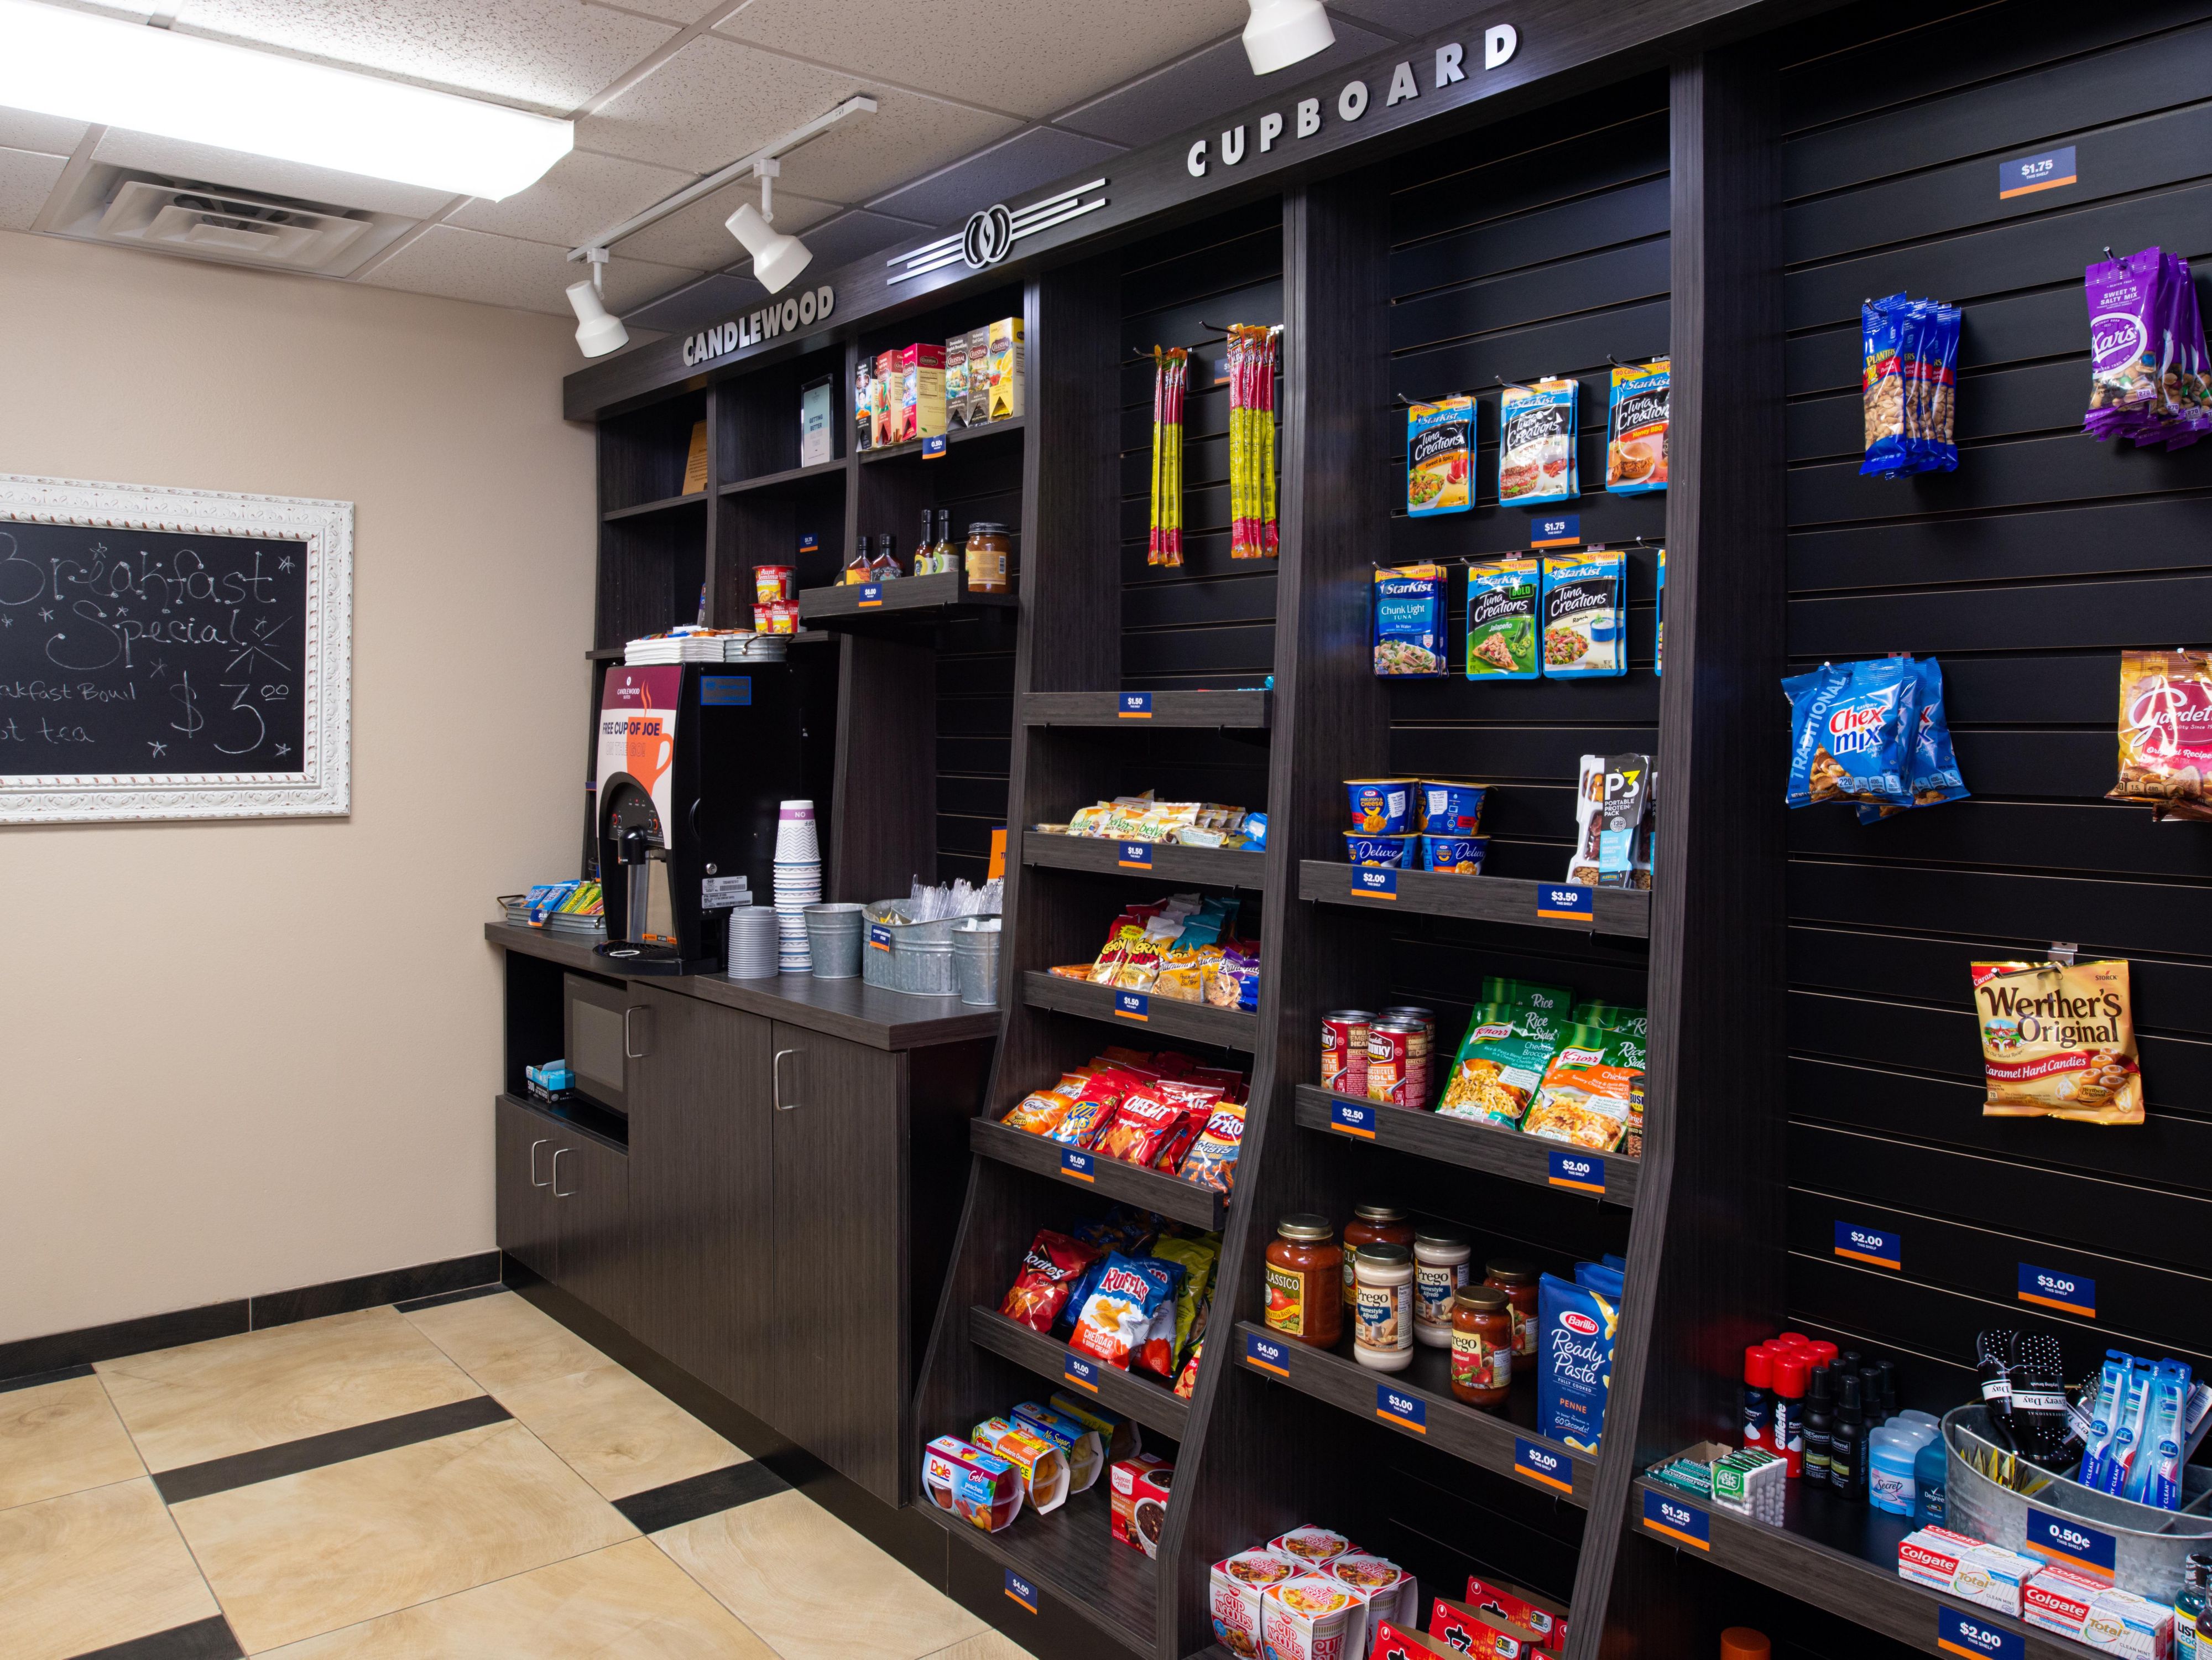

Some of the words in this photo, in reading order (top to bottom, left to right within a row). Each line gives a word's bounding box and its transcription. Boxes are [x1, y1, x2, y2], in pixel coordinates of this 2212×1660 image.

[1187, 24, 1517, 178] CUPBOARD
[2021, 160, 2053, 176] $1.75
[2100, 296, 2121, 305] SALTY
[2124, 292, 2137, 300] MIX
[2104, 290, 2127, 299] SWEET
[682, 285, 836, 367] CANDLEWOOD
[969, 348, 987, 358] CELESTIAL
[992, 341, 1009, 351] CELESTIAL
[948, 355, 965, 365] CELESTIAL
[1866, 348, 1896, 366] PLANTERS
[809, 414, 823, 424] GETTING
[1423, 413, 1458, 425] StarKist
[810, 423, 822, 431] BETTER
[1419, 431, 1440, 445] Tuna
[1415, 435, 1462, 461] Creations
[1544, 522, 1565, 532] $1.75
[1560, 566, 1601, 579] StarKist
[1386, 581, 1432, 594] StarKist
[1558, 587, 1582, 602] Tuna
[1479, 593, 1503, 607] Tuna
[1551, 592, 1606, 617] Creations
[1381, 605, 1405, 615] Chunk
[1407, 603, 1425, 616] Light
[1475, 600, 1528, 622] Creations
[46, 600, 247, 669] Special
[1489, 622, 1512, 633] Jalapeño
[1128, 697, 1142, 705] $1.50
[1790, 676, 1847, 779] TRADITIONAL
[1830, 705, 1886, 735] Chex
[603, 722, 614, 735] FREE
[614, 722, 628, 735] CUP
[629, 722, 641, 735] OF
[642, 722, 660, 736] JOE
[1834, 724, 1881, 756] mix
[1128, 847, 1142, 855] $1.50
[1357, 841, 1398, 859] Deluxe
[1363, 872, 1385, 883] $2.00
[1552, 891, 1578, 903] $3.50
[1102, 939, 1128, 955] CORN
[1132, 939, 1161, 956] CORN
[1124, 996, 1139, 1006] $1.50
[1531, 994, 1553, 1009] Rice
[1981, 986, 2122, 1019] Werther's
[1525, 1012, 1548, 1028] Rice
[1475, 1025, 1511, 1039] Knorr
[2017, 1017, 2119, 1049] Original
[1562, 1050, 1602, 1065] Knorr
[1985, 1064, 2021, 1079] Caramel
[2022, 1062, 2047, 1079] Hard
[2048, 1056, 2086, 1072] Candies
[1342, 1107, 1364, 1120] $2.50
[1070, 1154, 1085, 1165] $1.00
[1563, 1160, 1590, 1173] $2.00
[1851, 1231, 1882, 1247] $2.00
[1417, 1267, 1448, 1286] Prego
[2037, 1274, 2075, 1292] $3.00
[1099, 1267, 1150, 1304] RUFFLES
[1357, 1287, 1389, 1307] Prego
[1280, 1309, 1293, 1317] BASIL
[1360, 1306, 1383, 1314] Homestyle
[1568, 1315, 1596, 1331] Barilla
[1084, 1329, 1113, 1349] CHEDDAR
[1086, 1340, 1095, 1350] SOUR
[1095, 1343, 1109, 1355] CREAM
[1257, 1342, 1279, 1357] $4.00
[1551, 1328, 1605, 1370] Ready
[1073, 1361, 1089, 1374] $1.00
[1554, 1351, 1597, 1385] Pasta
[1558, 1377, 1571, 1386] FULLY
[1572, 1381, 1592, 1393] COOKED
[1389, 1394, 1413, 1411] $3.00
[1559, 1398, 1587, 1414] PENNE
[2022, 1396, 2042, 1406] Day
[1554, 1416, 1564, 1425] 60
[1564, 1418, 1589, 1434] Seconds!
[1775, 1401, 1787, 1450] Gillette
[1043, 1430, 1052, 1440] No
[1052, 1434, 1070, 1447] Sugar
[1803, 1429, 1830, 1439] TRESemmé
[938, 1439, 954, 1447] Dole
[999, 1444, 1016, 1458] Mandarin
[1016, 1453, 1031, 1465] Oranges
[1529, 1449, 1557, 1468] $2.00
[930, 1459, 951, 1479] Dole
[968, 1470, 984, 1484] Gel
[1113, 1472, 1131, 1484] Duncan
[1721, 1478, 1736, 1488] tac
[1724, 1472, 1738, 1482] tic
[964, 1482, 983, 1494] peaches
[1115, 1481, 1130, 1490] Hines
[1876, 1479, 1903, 1492] Secret
[1924, 1491, 1945, 1503] Degree
[1661, 1503, 1691, 1523] $1.25
[1674, 1518, 1686, 1526] SHELF
[1927, 1525, 1982, 1545] Colgate
[2049, 1525, 2090, 1548] 0.50¢
[2069, 1542, 2083, 1551] SHELF
[1900, 1545, 1955, 1571] Colgate
[1013, 1579, 1029, 1595] $4.00
[1958, 1571, 1991, 1588] Total
[1223, 1593, 1245, 1612] CUP
[1986, 1593, 2002, 1602] CLEAN
[2002, 1597, 2015, 1606] MINT
[2026, 1588, 2086, 1618] Colgate
[1215, 1599, 1253, 1630] NOODLES
[1226, 1619, 1237, 1627] BEEF
[1275, 1620, 1297, 1641] CUP
[1959, 1622, 2001, 1647] $2.00
[1267, 1625, 1305, 1660] NOODLES
[1312, 1633, 1345, 1655] CUP
[1979, 1640, 1994, 1650] SHELF
